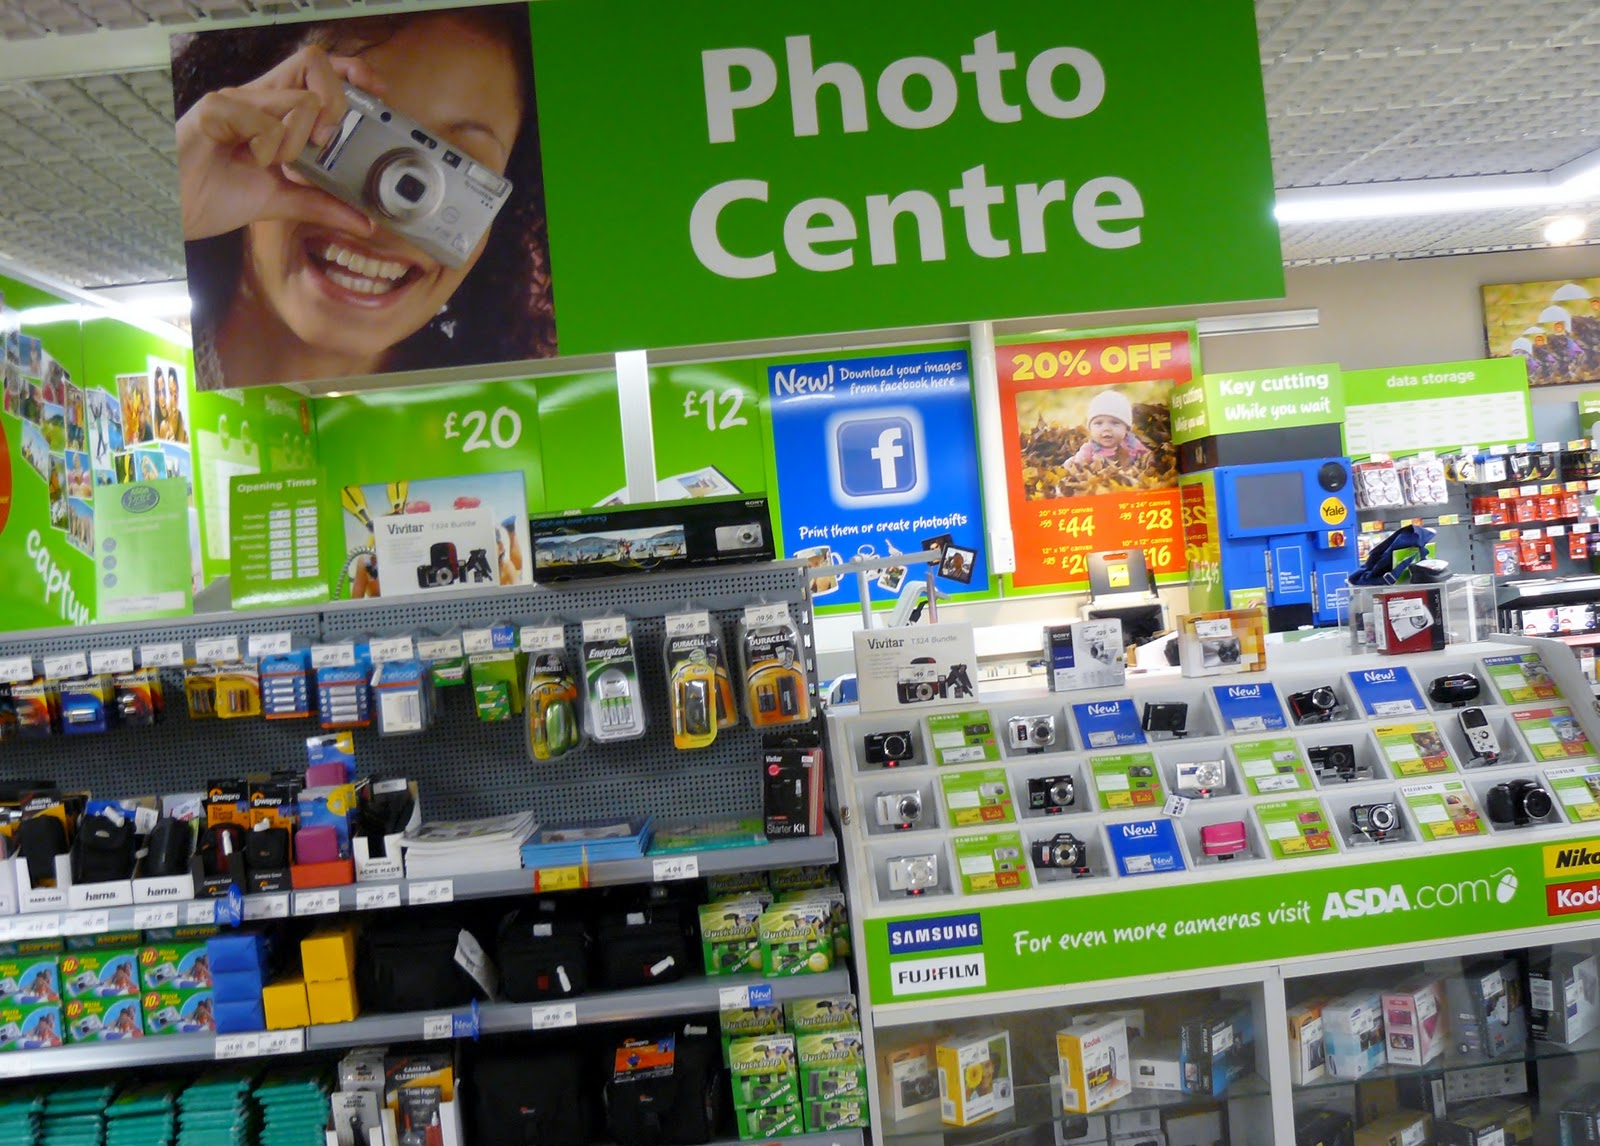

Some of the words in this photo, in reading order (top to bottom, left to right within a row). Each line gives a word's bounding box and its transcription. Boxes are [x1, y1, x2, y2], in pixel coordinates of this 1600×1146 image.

[701, 30, 1106, 144] Photo
[689, 164, 1145, 279] Centre
[1012, 349, 1093, 381] 20%
[1100, 342, 1172, 374] OFF
[775, 365, 834, 396] New!
[839, 364, 894, 381] Download
[896, 364, 921, 379] your
[924, 361, 962, 376] images
[1219, 377, 1255, 398] Key
[1261, 371, 1329, 394] cutting
[1387, 375, 1418, 388] data
[1422, 370, 1475, 385] storage
[850, 381, 877, 395] from
[880, 377, 928, 392] facebook
[930, 376, 955, 388] here
[683, 388, 748, 432] £12
[1225, 402, 1267, 421] While
[1272, 403, 1297, 419] you
[1301, 397, 1331, 416] wait
[444, 406, 522, 452] £20
[870, 427, 904, 489] f
[237, 482, 283, 494] Opening
[286, 479, 317, 488] Times
[1322, 505, 1345, 517] Yale
[1138, 508, 1173, 530] £28
[387, 524, 424, 535] Vivitar
[799, 524, 829, 540] Print
[831, 523, 859, 536] them
[861, 523, 874, 534] or
[876, 519, 910, 533] create
[912, 513, 968, 533] photogifts
[1058, 515, 1096, 538] £44
[493, 632, 513, 642] New!
[750, 635, 790, 646] DURACELL
[867, 638, 905, 649] Vivitar
[931, 635, 957, 643] Bundle
[672, 639, 705, 649] DURACELL
[589, 647, 627, 659] Energizer
[218, 665, 256, 674] Panasonic
[266, 662, 300, 672] eneloop
[114, 676, 146, 685] Panasonic
[324, 672, 361, 681] eneloop
[381, 670, 418, 680] neloop
[1364, 670, 1395, 682] New!
[12, 687, 43, 695] Panasonic
[61, 682, 100, 691] Panasonic
[1229, 686, 1260, 698] New!
[1088, 702, 1119, 716] New!
[1264, 717, 1282, 726] New!
[1117, 732, 1136, 741] New!
[1404, 785, 1433, 793] FUJIFILM
[212, 793, 240, 802] lowepro
[254, 798, 282, 806] lowepro
[1257, 802, 1288, 810] FUJIFILM
[767, 825, 791, 834] Starter
[793, 823, 805, 833] Kit
[1122, 822, 1157, 837] New!
[1153, 856, 1173, 865] New!
[359, 868, 378, 876] ACME
[381, 866, 400, 874] MADE
[1557, 886, 1600, 908] Kod
[1013, 930, 1052, 956] For
[1058, 930, 1107, 951] even
[1113, 922, 1167, 943] more
[1174, 911, 1261, 937] cameras
[1267, 901, 1311, 925] visit
[1322, 877, 1491, 921] ASDA.com
[703, 925, 750, 938] QuickSnap
[763, 928, 811, 940] QuickSnap
[892, 923, 979, 945] SAMSUNG
[732, 960, 743, 972] One
[790, 963, 801, 974] One
[899, 964, 980, 984] FUJIFILM
[751, 990, 771, 1000] New!
[722, 1017, 771, 1029] QuickSnap
[797, 1014, 845, 1026] QuickSnap
[1083, 1037, 1102, 1049] Kodak
[801, 1050, 850, 1063] QuickSnap
[404, 1065, 431, 1073] CAMERA
[733, 1057, 781, 1070] QuickSnap
[761, 1095, 771, 1106] One
[770, 1089, 782, 1100] Time
[781, 1083, 791, 1093] Use
[824, 1090, 835, 1100] One
[834, 1085, 847, 1095] Time
[765, 1126, 777, 1137] One
[775, 1120, 787, 1131] Time
[786, 1114, 796, 1124] Use
[826, 1120, 838, 1131] One
[836, 1115, 850, 1126] Time
